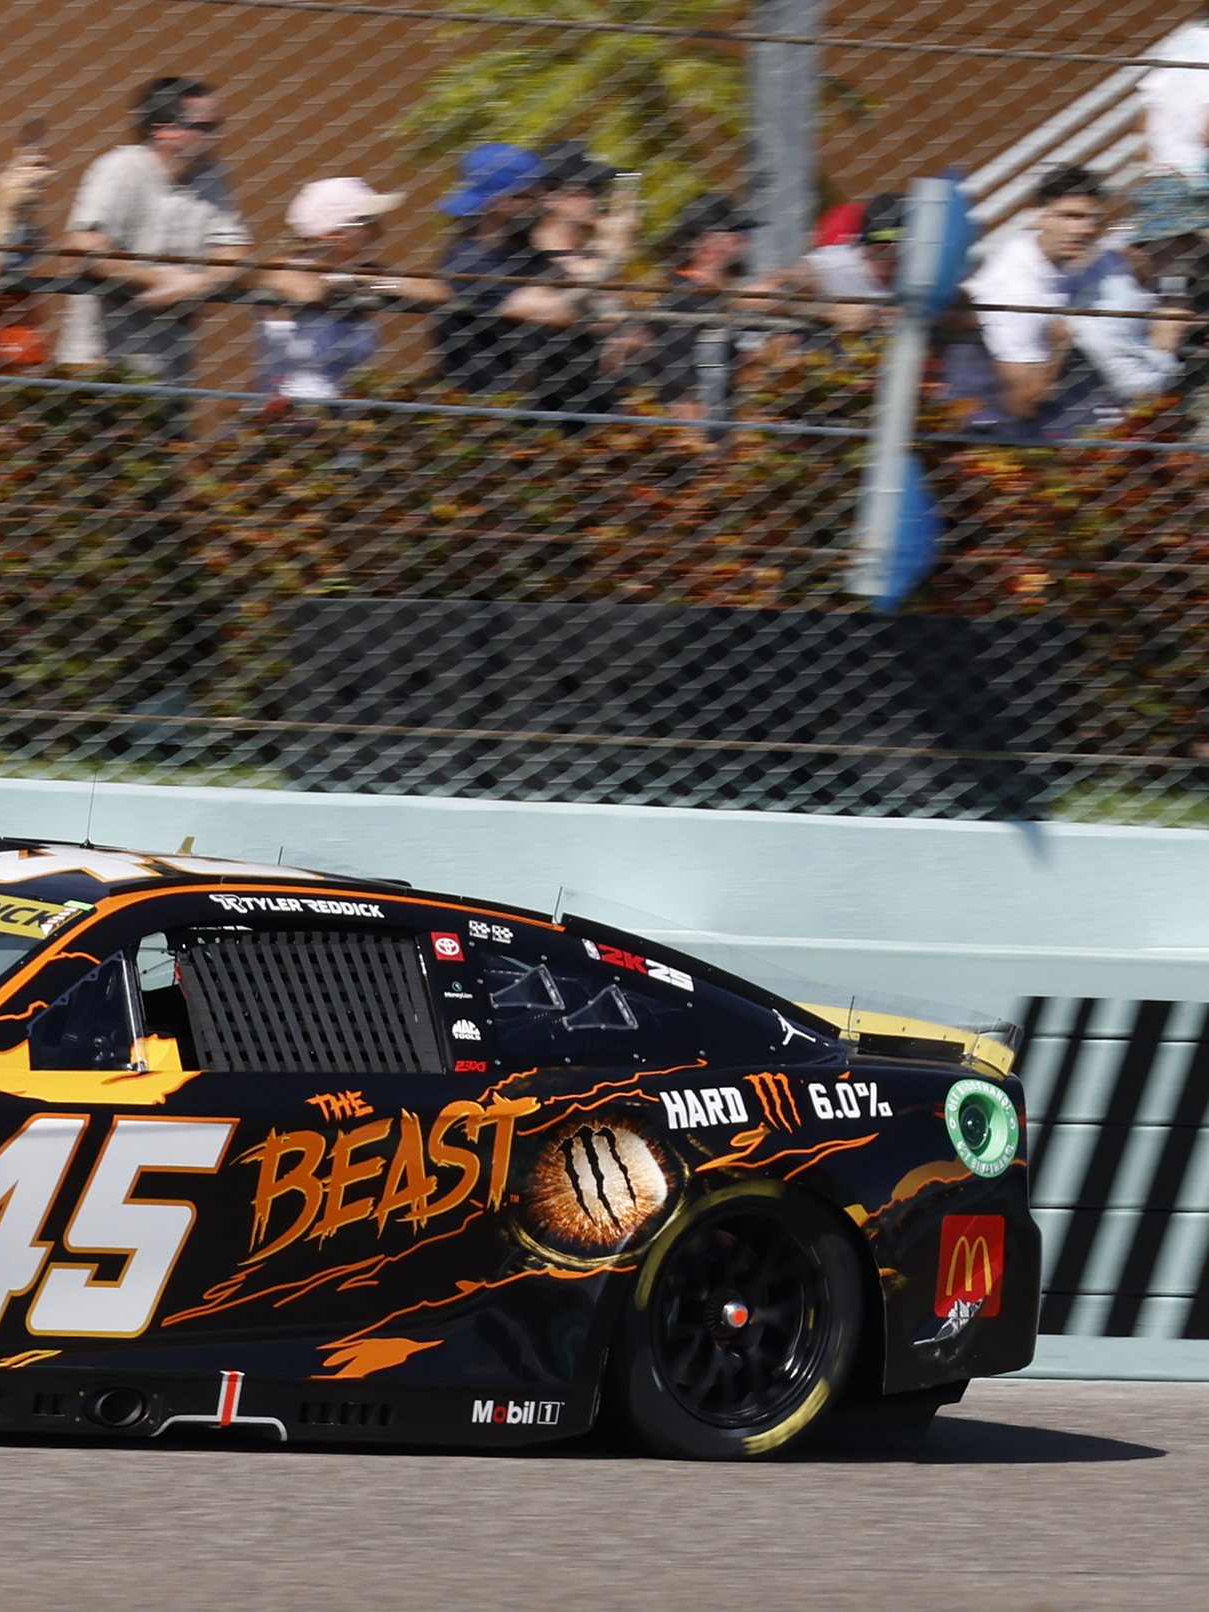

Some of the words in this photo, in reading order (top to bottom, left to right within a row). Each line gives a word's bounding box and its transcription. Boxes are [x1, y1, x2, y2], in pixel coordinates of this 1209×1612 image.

[240, 897, 304, 912] TYLER
[300, 898, 385, 918] REDDICK
[597, 942, 695, 992] 2K25
[454, 1033, 481, 1041] TOOLS
[305, 1090, 375, 1122] THE
[659, 1087, 749, 1130] HARD
[808, 1082, 893, 1120] 6.0%
[229, 1091, 541, 1266] BEAST
[472, 1399, 536, 1425] Mobil
